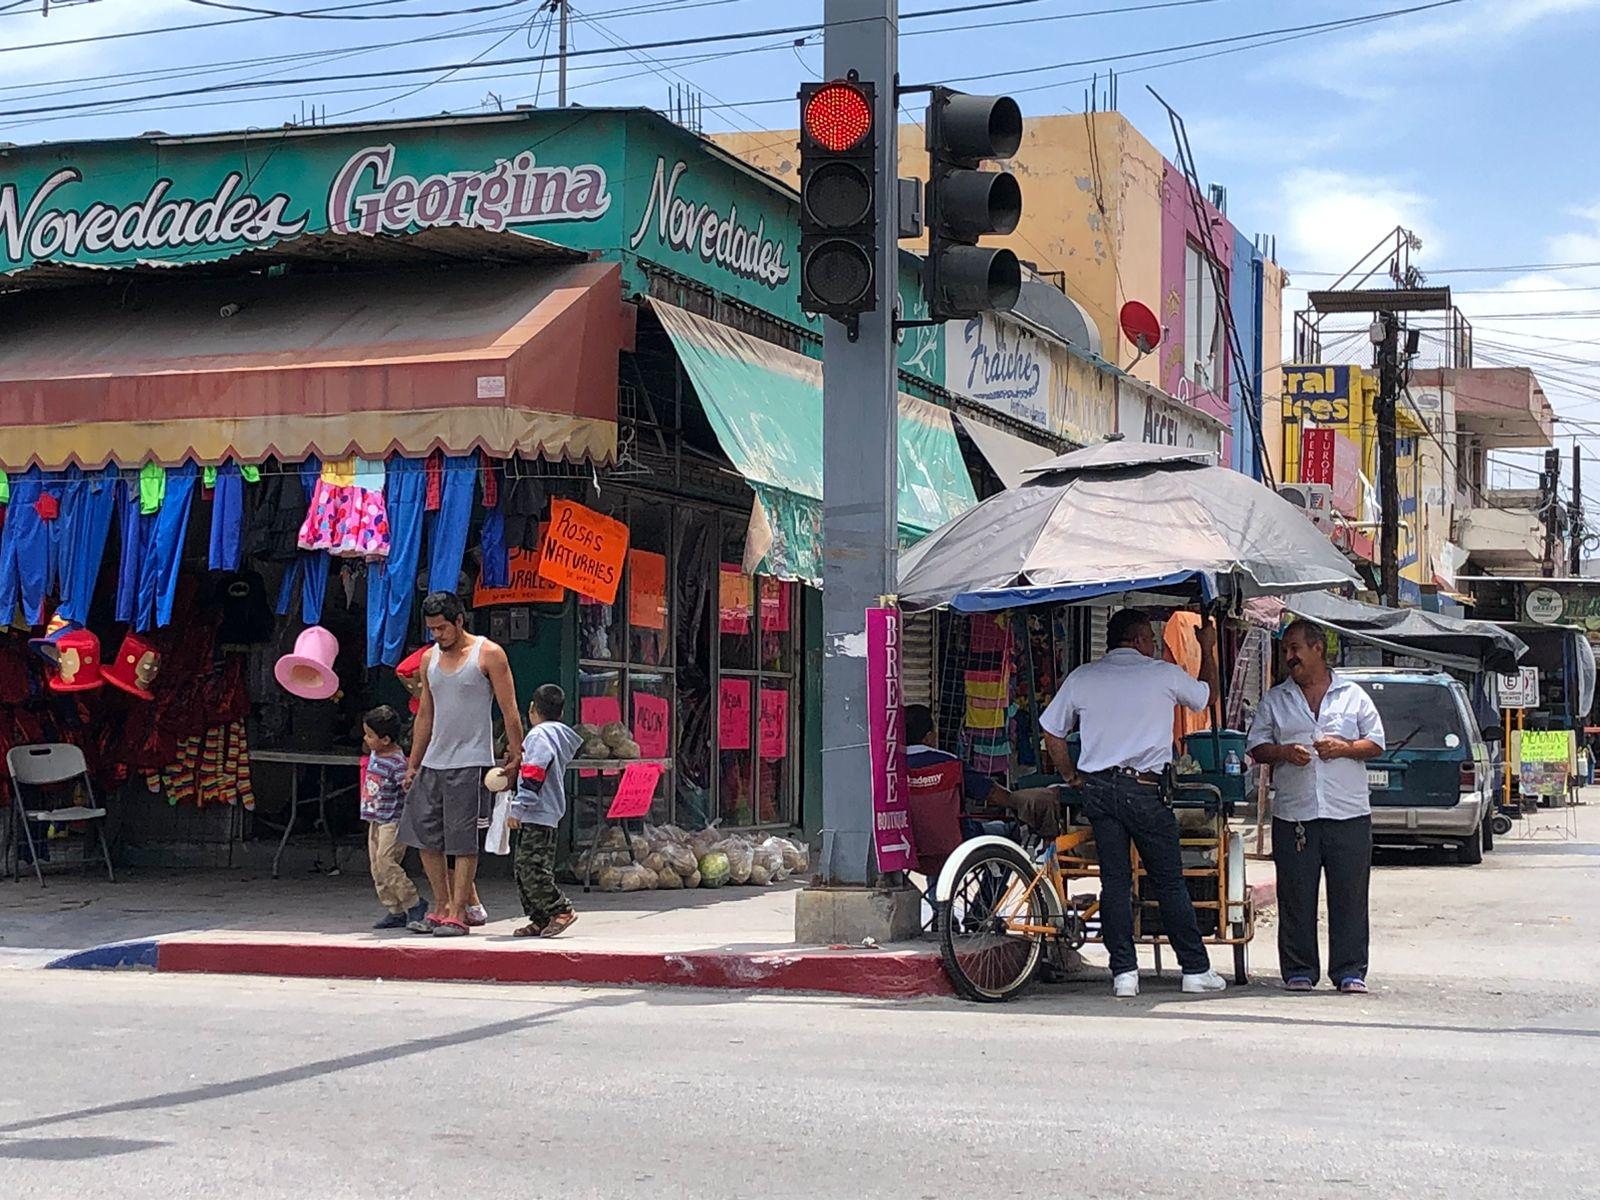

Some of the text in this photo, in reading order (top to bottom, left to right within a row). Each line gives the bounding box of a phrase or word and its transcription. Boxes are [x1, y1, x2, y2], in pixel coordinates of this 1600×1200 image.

[0, 143, 611, 261] Novedades Georgina
[630, 156, 789, 290] Novedades
[556, 507, 604, 553] ROSAS
[885, 614, 899, 804] BREZZE
